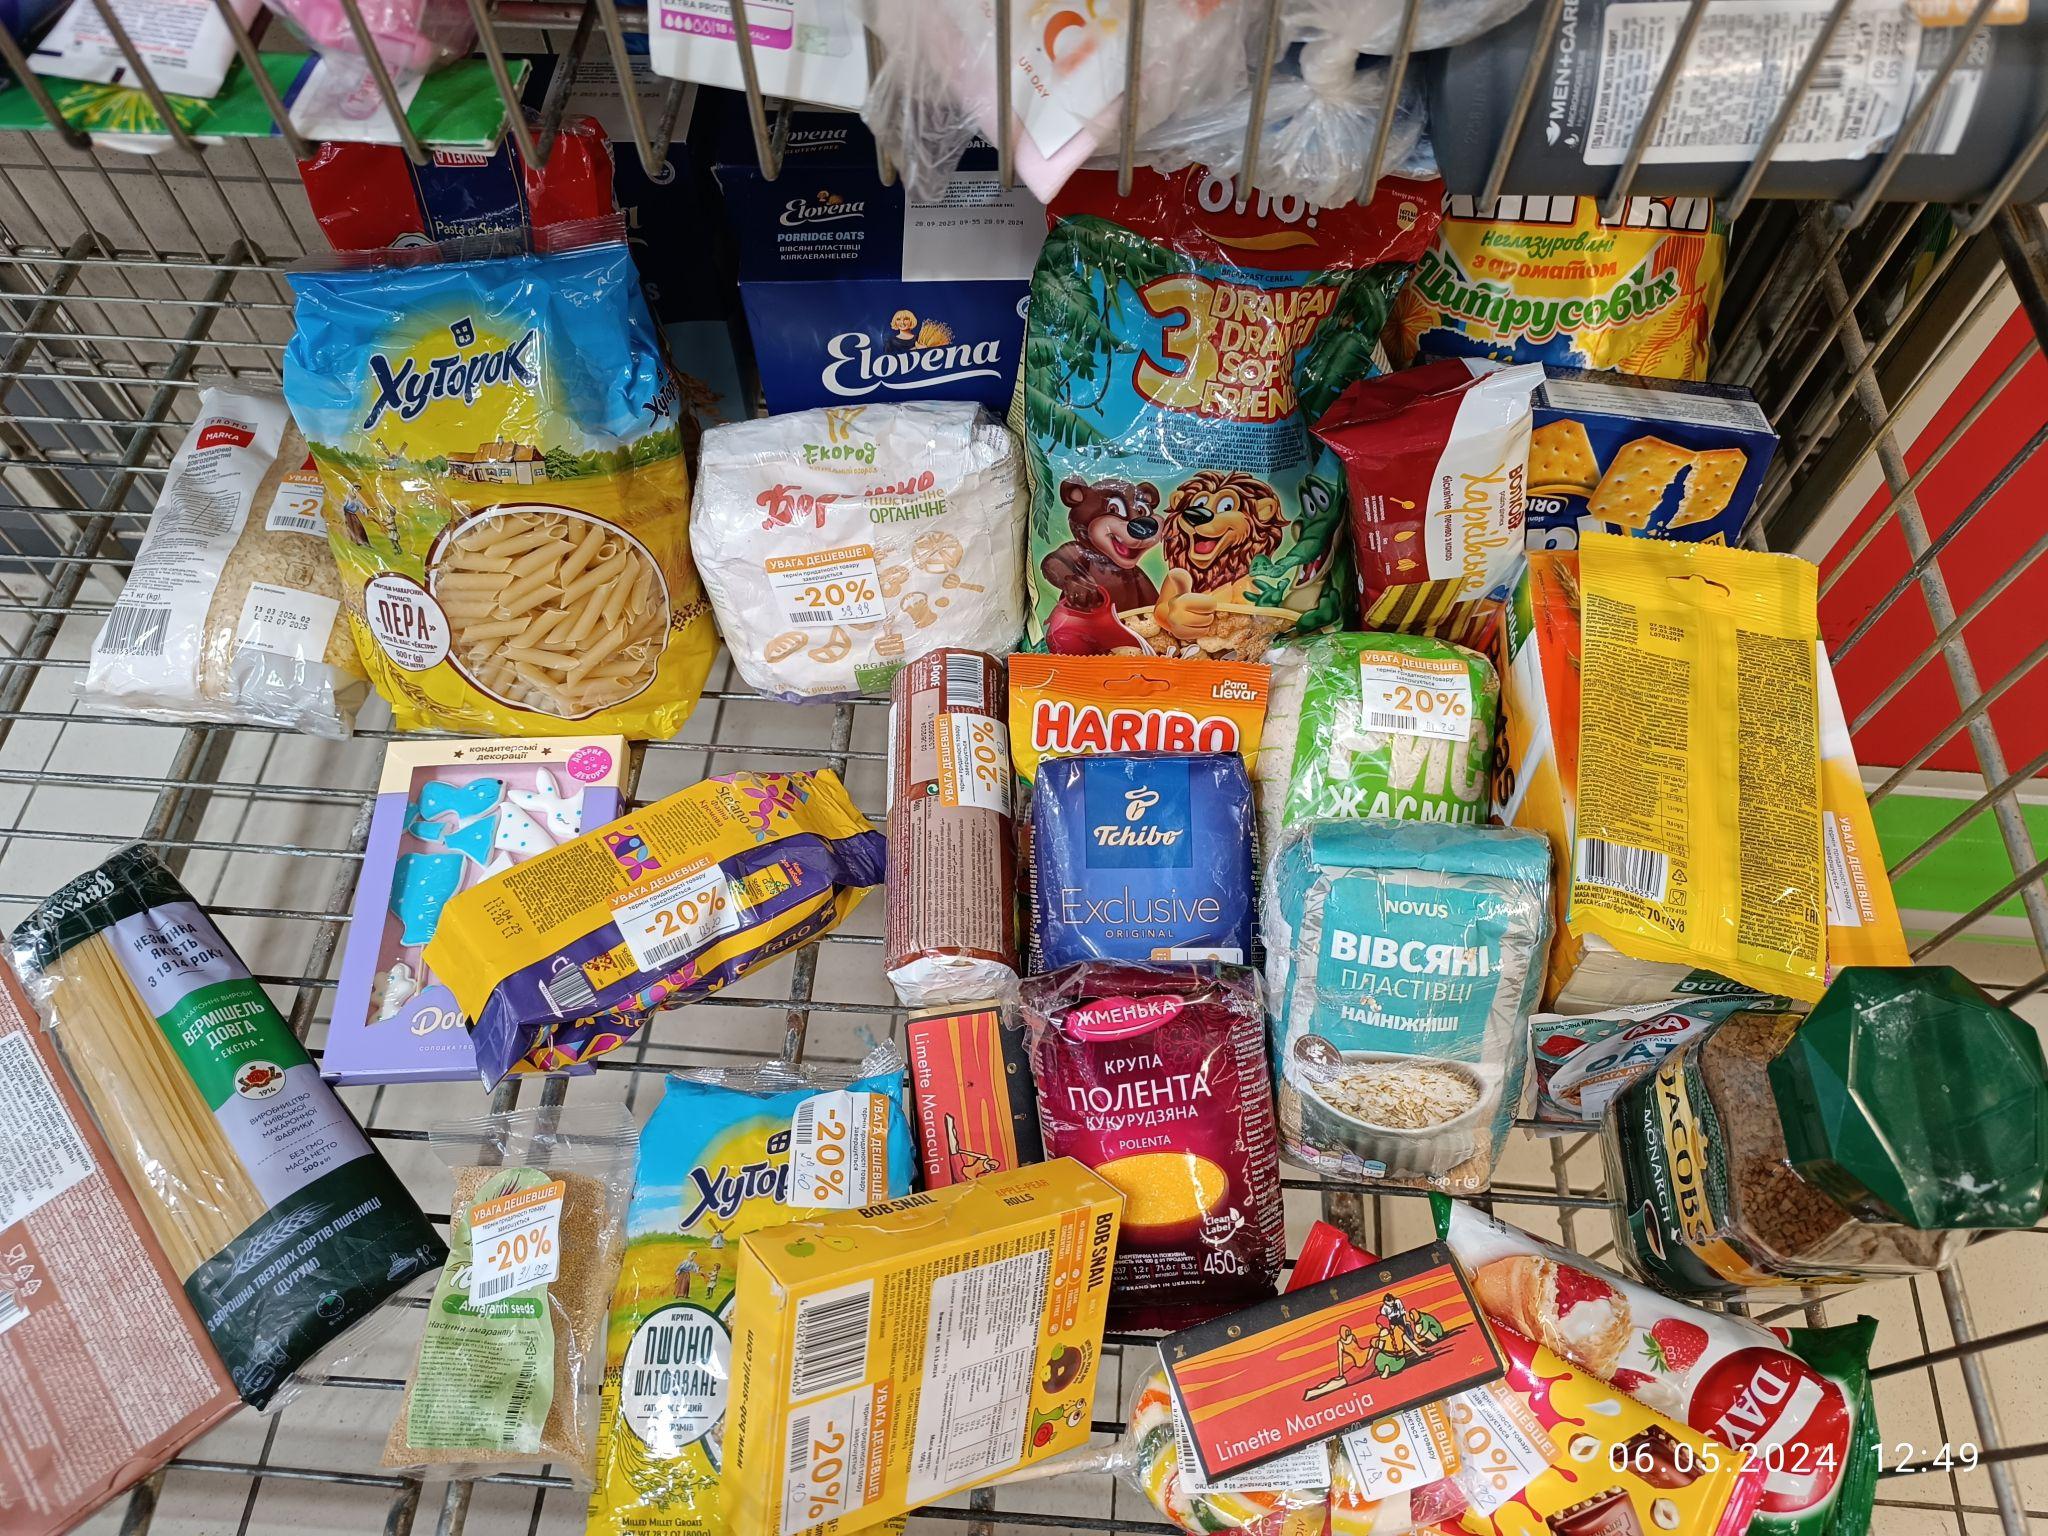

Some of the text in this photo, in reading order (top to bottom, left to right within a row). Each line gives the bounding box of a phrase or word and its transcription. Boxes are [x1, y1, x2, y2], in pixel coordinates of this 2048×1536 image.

[716, 19, 727, 33] 18
[1031, 75, 1050, 98] DAY
[779, 199, 865, 226] Elovena
[436, 221, 465, 236] Pasta
[778, 231, 865, 242] PORRIDGE OATS
[781, 253, 858, 261] KIIRKAERAHELBED
[815, 244, 861, 252] ПЛАСТІВЦІ
[1480, 231, 1617, 260] Неглазуровані
[1265, 273, 1294, 282] CEREAL
[1488, 259, 1618, 281] ароматом
[1211, 286, 1335, 322] DRAUGAI
[1413, 251, 1679, 337] Цитрусових
[1135, 277, 1218, 407] 3
[822, 332, 1002, 396] Elovena
[363, 330, 537, 430] Хуторок
[205, 431, 240, 441] MARKA
[210, 419, 248, 430] PROMO
[288, 474, 320, 483] УВАГА
[869, 499, 948, 524] ОРГАНІЧНЕ
[770, 548, 867, 570] УВАГА ДЕШЕВШЕ!
[803, 566, 838, 577] придатності
[839, 562, 860, 571] товару
[802, 572, 843, 583] завершується
[794, 579, 875, 607] -20%
[254, 605, 311, 623] 13 03 2024 02
[263, 615, 308, 630] 22 07 2025
[376, 599, 436, 641] «ПЕРА»
[1649, 622, 1685, 633] 07.03.2024
[1649, 627, 1685, 638] 07.03.2025
[1364, 653, 1463, 671] УВАГА ДЕШЕВШЕ!
[930, 664, 942, 687] 300g
[1223, 680, 1248, 690] Para
[1212, 686, 1258, 700] Llevar
[1382, 687, 1466, 717] -20%
[1036, 703, 1236, 753] HARIBO
[469, 744, 538, 754] кондитерські
[476, 752, 528, 761] декорації
[572, 748, 603, 763] ДОБРИК
[939, 718, 955, 802] УВАГА ДЕШЕВШЕ!
[972, 721, 997, 792] -20%
[575, 764, 608, 780] ДЕКОРУЄ
[715, 785, 751, 825] Stefano
[1325, 785, 1477, 825] ЖАСМІН
[1093, 825, 1184, 846] Tchibo
[611, 857, 711, 906] УВАГА ДЕШЕВШЕ!
[1839, 817, 1874, 922] УВАГА ДЕШЕВШЕ!
[649, 883, 685, 901] придатності
[685, 873, 706, 886] товару
[1588, 876, 1620, 888] 823077
[1625, 885, 1655, 899] 636257
[1592, 885, 1611, 895] НЕТТО/
[493, 896, 523, 937] 13.04.25
[645, 886, 726, 937] -20%
[1061, 886, 1220, 925] Exclusive
[1385, 899, 1449, 919] NOVUS
[1646, 907, 1660, 922] 70
[134, 923, 197, 952] НЕЗМІННА
[1104, 929, 1175, 938] ORIGINAL
[151, 938, 198, 959] ЯКІСТЬ
[1330, 929, 1489, 977] ВІВСЯНІ
[157, 949, 224, 978] 1914 РОКУ
[1341, 969, 1473, 1004] ПЛАСТІВЦІ
[177, 990, 253, 1028] МАКАРОННІ ВИРОБИ
[1076, 1000, 1177, 1028] ЖМЕНЬКА
[1340, 1005, 1459, 1032] НАЙНІЖНІШІ
[182, 1001, 265, 1046] ВЕРМІШЕЛЬ
[206, 1020, 257, 1050] ДОВГА
[1625, 1016, 1683, 1040] AXA
[220, 1039, 257, 1059] ЕКСТРА
[1104, 1054, 1164, 1075] КРУПА
[258, 1087, 276, 1097] 1914
[915, 1033, 940, 1175] Limette Maracuja
[1067, 1073, 1213, 1113] ПОЛЕНТА
[249, 1092, 311, 1126] ВИРОБНИЦТВО
[262, 1103, 307, 1128] КИЇВСЬКОЇ
[872, 1099, 885, 1136] УВАГА
[1086, 1105, 1198, 1129] КУКУРУДЗЯНА
[262, 1106, 318, 1138] МАКАРОННОЇ
[275, 1120, 315, 1142] ФАБРИКИ
[289, 1138, 324, 1160] БЕЗ ГМО
[814, 1109, 846, 1201] -20%
[1118, 1135, 1172, 1150] POLENTA
[285, 1141, 338, 1173] МАСА НЕТТО
[302, 1161, 319, 1173] 500
[1643, 1108, 1670, 1222] MONARCH
[1659, 1068, 1707, 1247] JACOBS
[996, 1178, 1050, 1198] APPLE-PEAR
[1426, 1175, 1451, 1188] 500
[1463, 1175, 1480, 1189] (g)
[474, 1186, 558, 1221] УВАГА ДЕШЕВШЕ!
[858, 1194, 938, 1220] BOB SNAIL
[1004, 1192, 1035, 1208] ROLLS
[1205, 1214, 1231, 1226] Clean
[1205, 1221, 1232, 1235] Label
[213, 1287, 255, 1327] БОРОШНА
[253, 1252, 299, 1292] ТВЕРДИХ
[297, 1226, 333, 1257] СОРТІВ
[332, 1196, 382, 1233] ПШЕНИЦІ
[488, 1226, 551, 1272] -20%
[1087, 1212, 1113, 1293] BOB SNAIL
[459, 1300, 535, 1315] Amaranth seeds
[671, 1313, 694, 1321] КРУПА
[644, 1325, 713, 1365] ПШОНО
[635, 1369, 717, 1396] ШЛІФОВАНЕ
[737, 1330, 754, 1469] www.bob-snail.com
[1216, 1393, 1374, 1461] Limette Maracuja
[1496, 1386, 1556, 1456] ДЕШЕВШЕ!
[867, 1385, 889, 1500] УВАГА ДЕШЕВШЕ!
[1423, 1436, 1436, 1460] товару
[1450, 1403, 1519, 1491] 20%
[1512, 1431, 1532, 1454] товару
[808, 1420, 846, 1519] -20%
